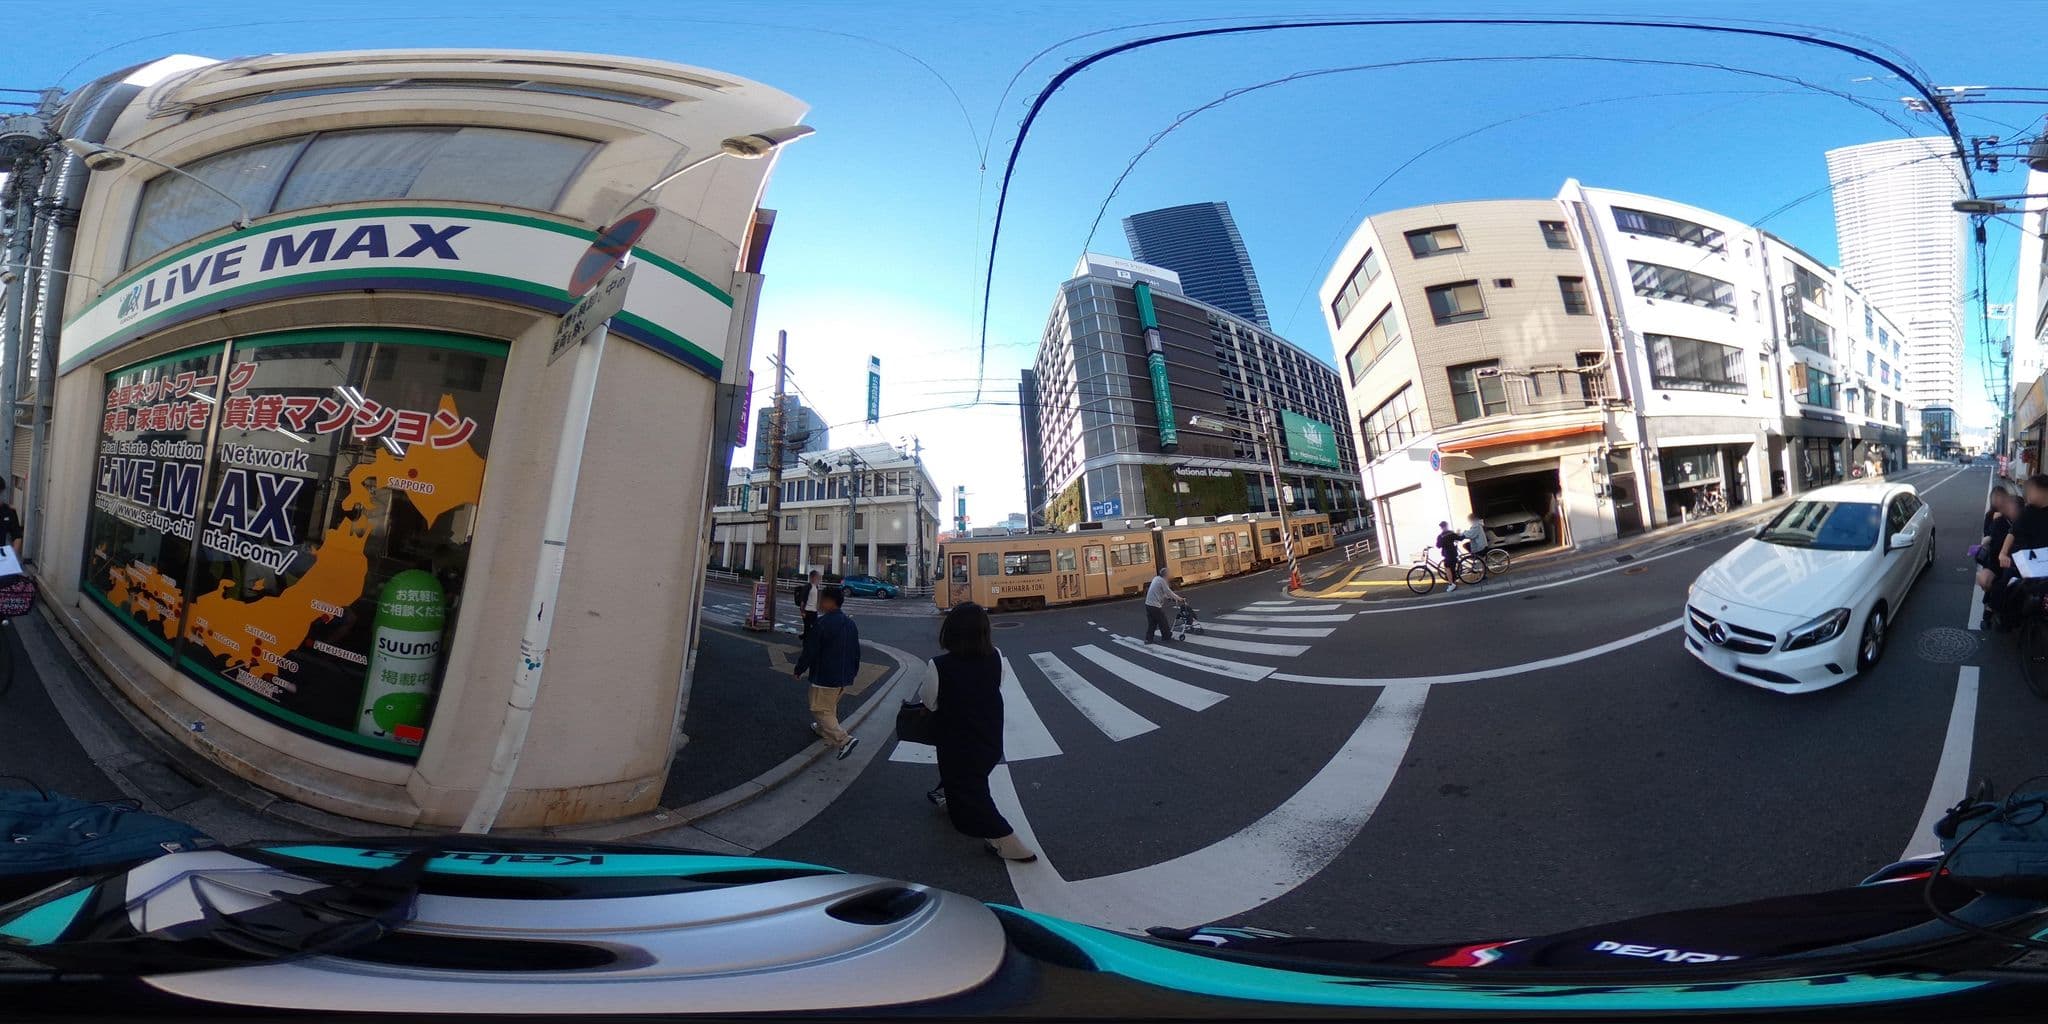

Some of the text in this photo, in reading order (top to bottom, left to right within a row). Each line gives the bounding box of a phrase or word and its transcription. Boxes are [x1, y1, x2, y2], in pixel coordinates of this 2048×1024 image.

[143, 244, 248, 312] LiVE
[259, 222, 472, 273] MAX
[101, 439, 309, 473] Real Estate Solution Network
[96, 455, 156, 506] LiVE
[387, 476, 434, 494] SAPPORO
[395, 589, 440, 602] お気軽に
[310, 599, 344, 617] SENDAI
[313, 640, 368, 665] FUKUSHIMA
[378, 637, 440, 656] suumo
[261, 649, 300, 673] TOKYO
